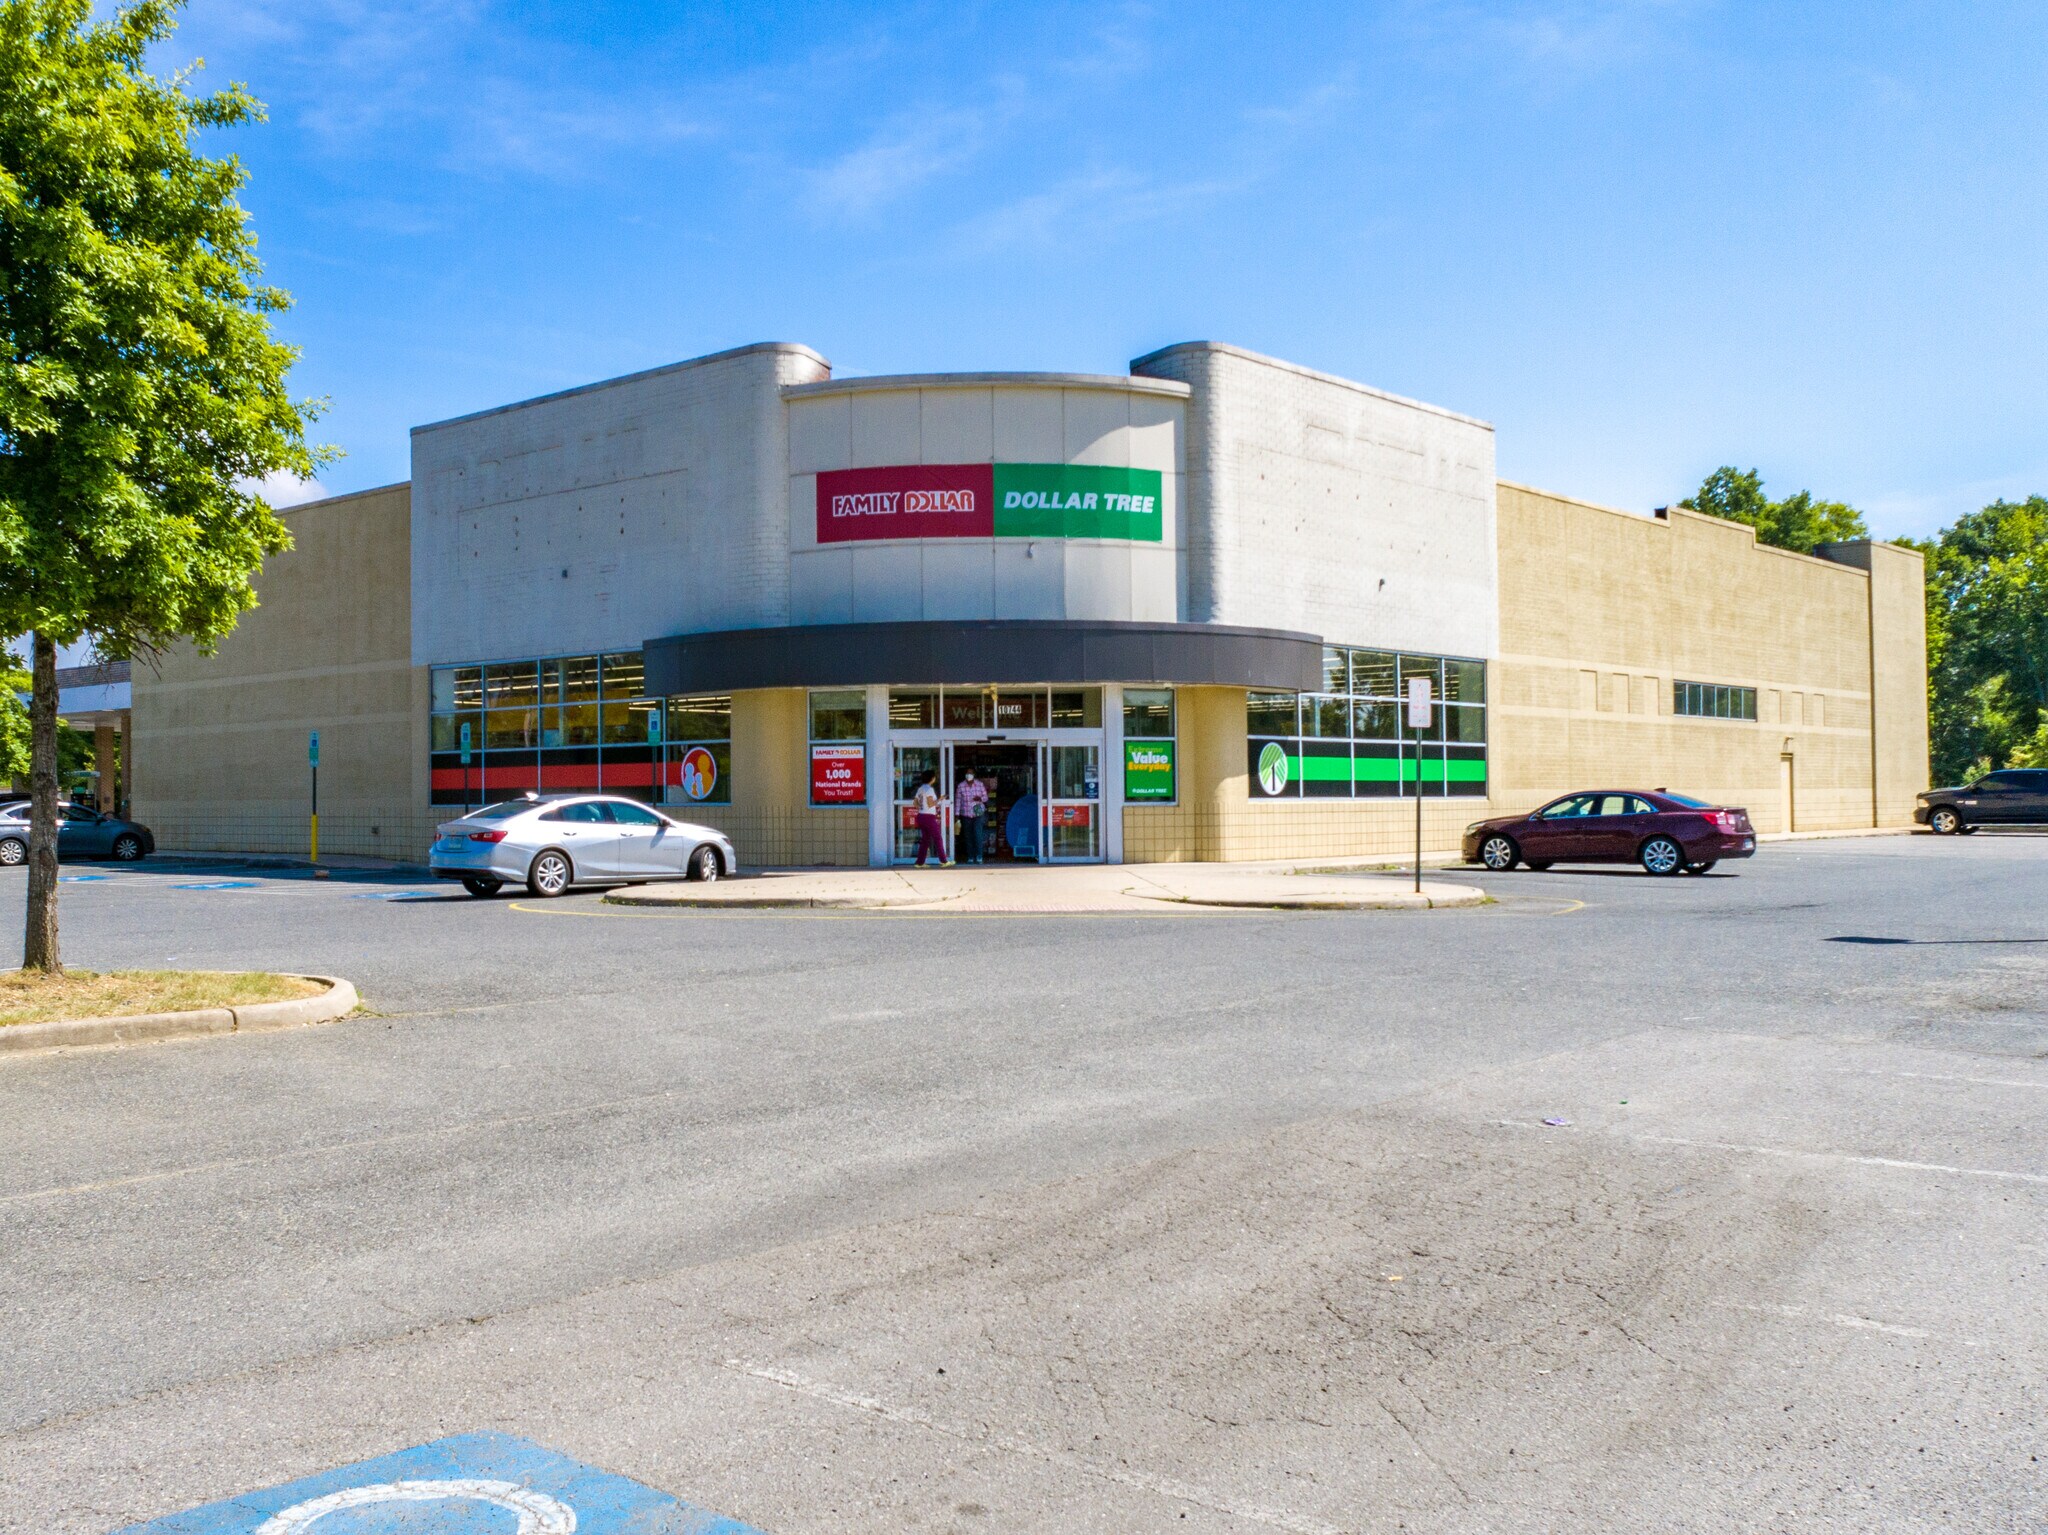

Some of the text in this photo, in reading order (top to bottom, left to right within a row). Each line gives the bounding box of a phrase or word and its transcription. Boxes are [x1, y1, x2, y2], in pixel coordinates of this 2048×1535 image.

[832, 489, 975, 517] FAMILY DOLLAR
[1003, 491, 1155, 513] DOLLAR TREE
[1131, 751, 1168, 764] Value
[1128, 762, 1171, 772] Everyday
[825, 769, 851, 779] 1,000
